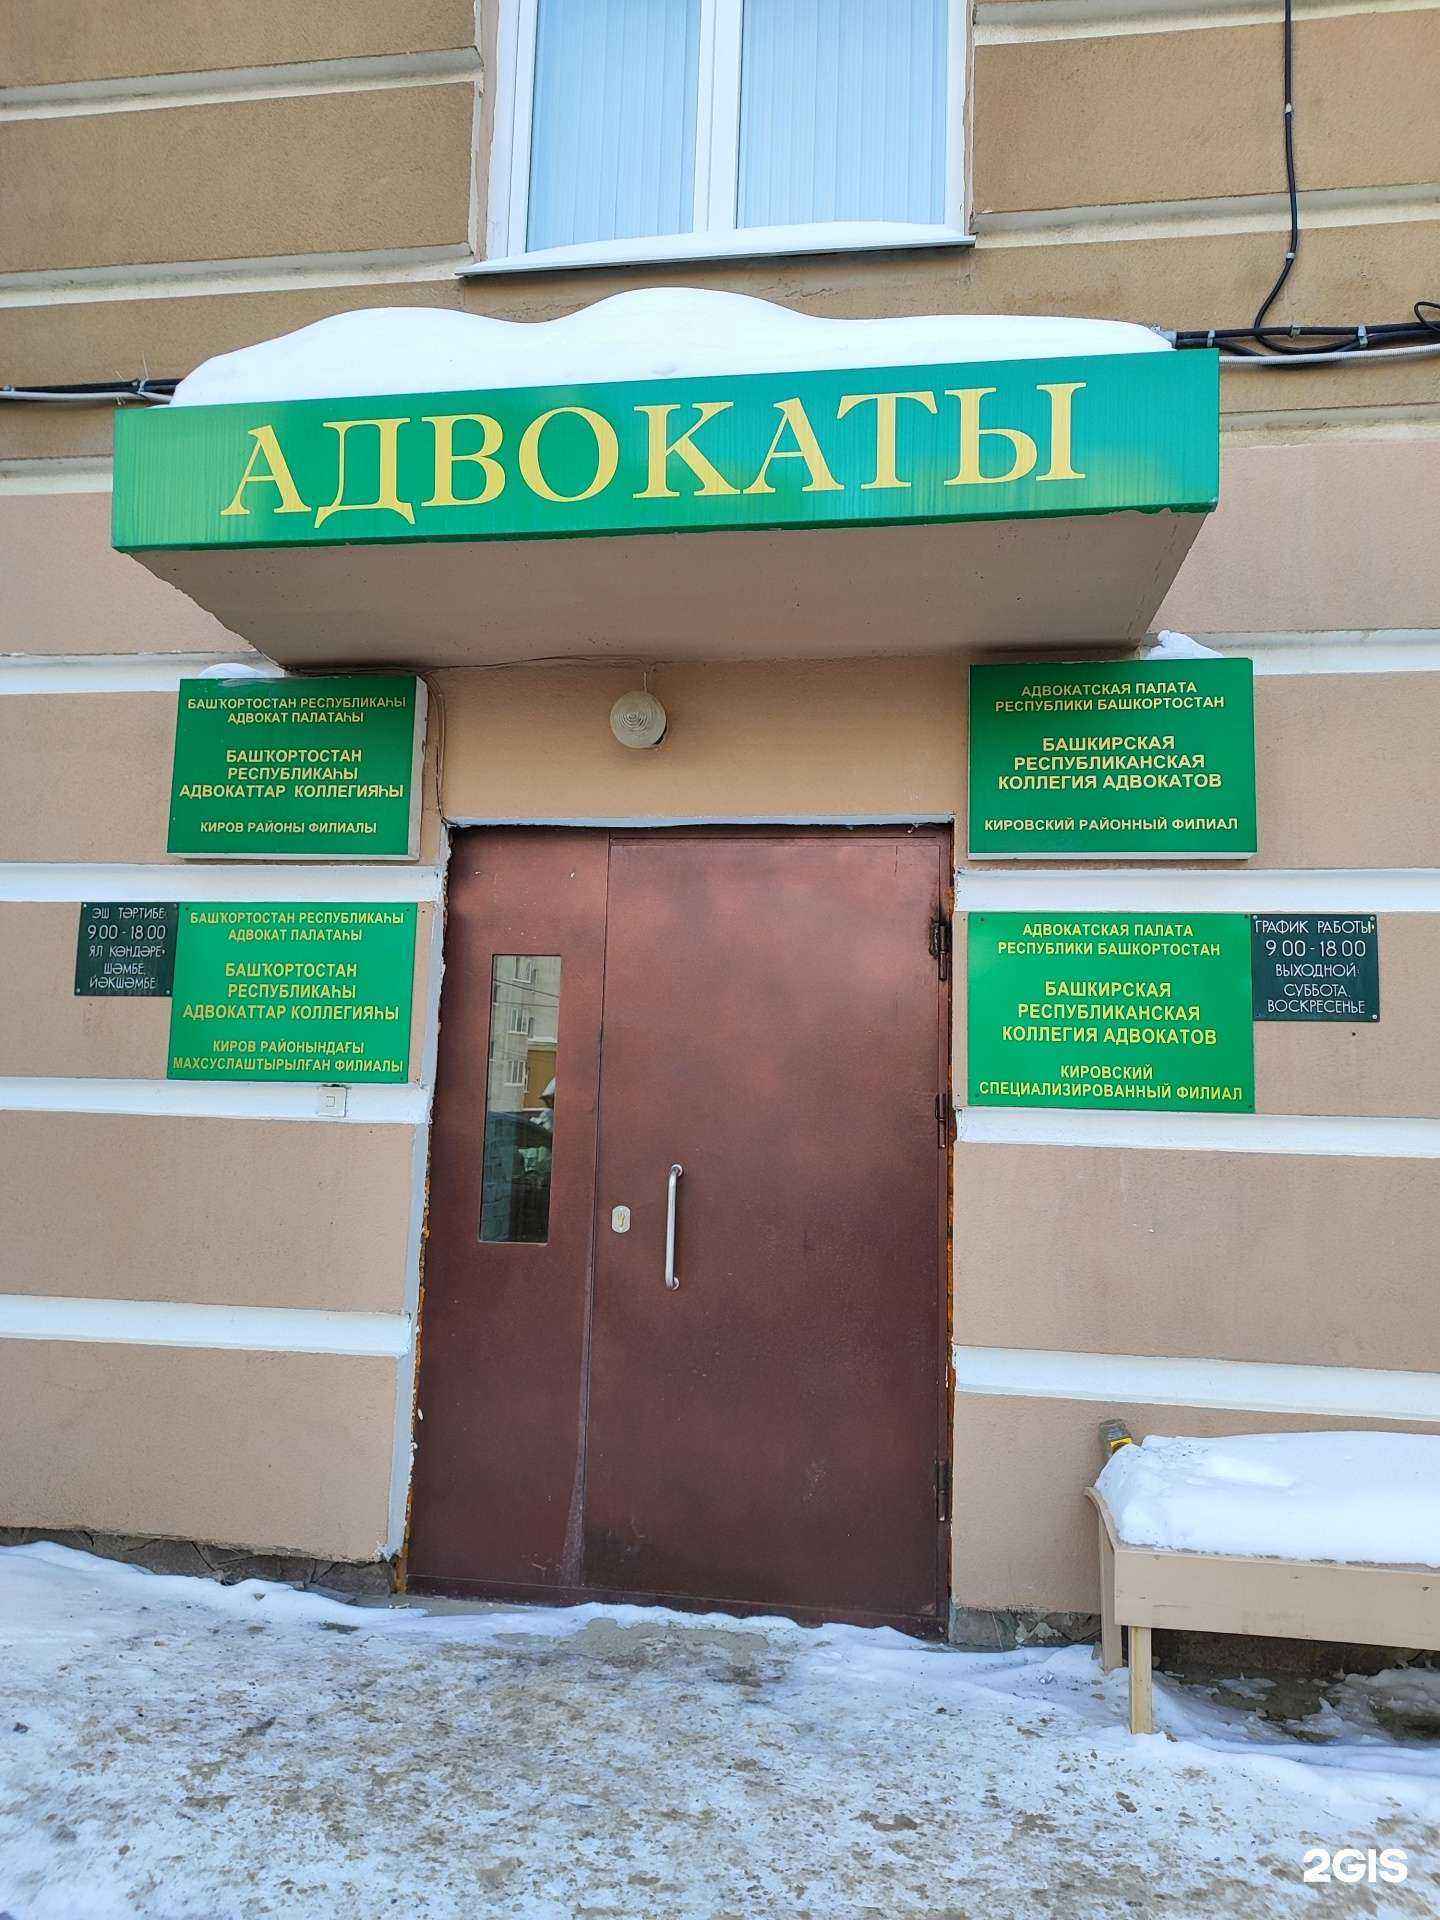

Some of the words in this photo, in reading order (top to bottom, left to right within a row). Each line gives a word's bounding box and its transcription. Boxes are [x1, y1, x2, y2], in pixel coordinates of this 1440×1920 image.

[219, 382, 1088, 528] АДВОКАТЫ
[1021, 683, 1131, 698] АДВОКАТСКАЯ
[1135, 681, 1197, 694] ПАЛАТА
[995, 699, 1093, 712] РЕСПУБЛИКИ
[1097, 696, 1224, 709] БАШКОРТОСТАН
[228, 712, 288, 724] АДВОКАТ
[1042, 736, 1175, 752] БАШКИРСКАЯ
[1014, 755, 1205, 770] РЕСПУБЛИКАНСКАЯ
[998, 775, 1097, 789] КОЛЛЕГИЯ
[1103, 774, 1222, 791] АДВОКАТОВ
[180, 785, 285, 799] АДВОКАТТАР
[200, 822, 244, 832] КИРОВ
[248, 819, 305, 833] РАЙОНЫ
[309, 822, 376, 833] ФИЛИАЛЫ
[984, 817, 1075, 831] КИРОВСКИЙ
[1079, 817, 1167, 830] РАЙОННЫЙ
[1171, 818, 1238, 830] ФИЛИАЛ
[1023, 924, 1129, 938] АДВОКАТСКАЯ
[1134, 924, 1193, 937] ПАЛАТА
[1255, 920, 1309, 934] ГРАФИК
[228, 929, 287, 942] АДВОКАТ
[998, 942, 1093, 955] РЕСПУБЛИКИ
[1098, 942, 1220, 956] БАШКОРТОСТАН
[1045, 982, 1171, 997] БАШКИРСКАЯ
[183, 1005, 286, 1020] АДВОКАТТАР
[1018, 1004, 1200, 1021] РЕСПУБЛИКАНСКАЯ
[1267, 999, 1366, 1014] ВОСКРЕСЕНЬЕ
[1002, 1027, 1098, 1042] КОЛЛЕГИЯ
[1104, 1029, 1217, 1045] АДВОКАТОВ
[213, 1041, 256, 1052] КИРОВ
[334, 1059, 402, 1072] ФИЛИАЛЫ
[1060, 1063, 1153, 1079] КИРОВСКИЙ
[979, 1081, 1171, 1099] СПЕЦИАЛИЗИРОВАННЫЙ
[1176, 1086, 1242, 1100] ФИЛИАЛ
